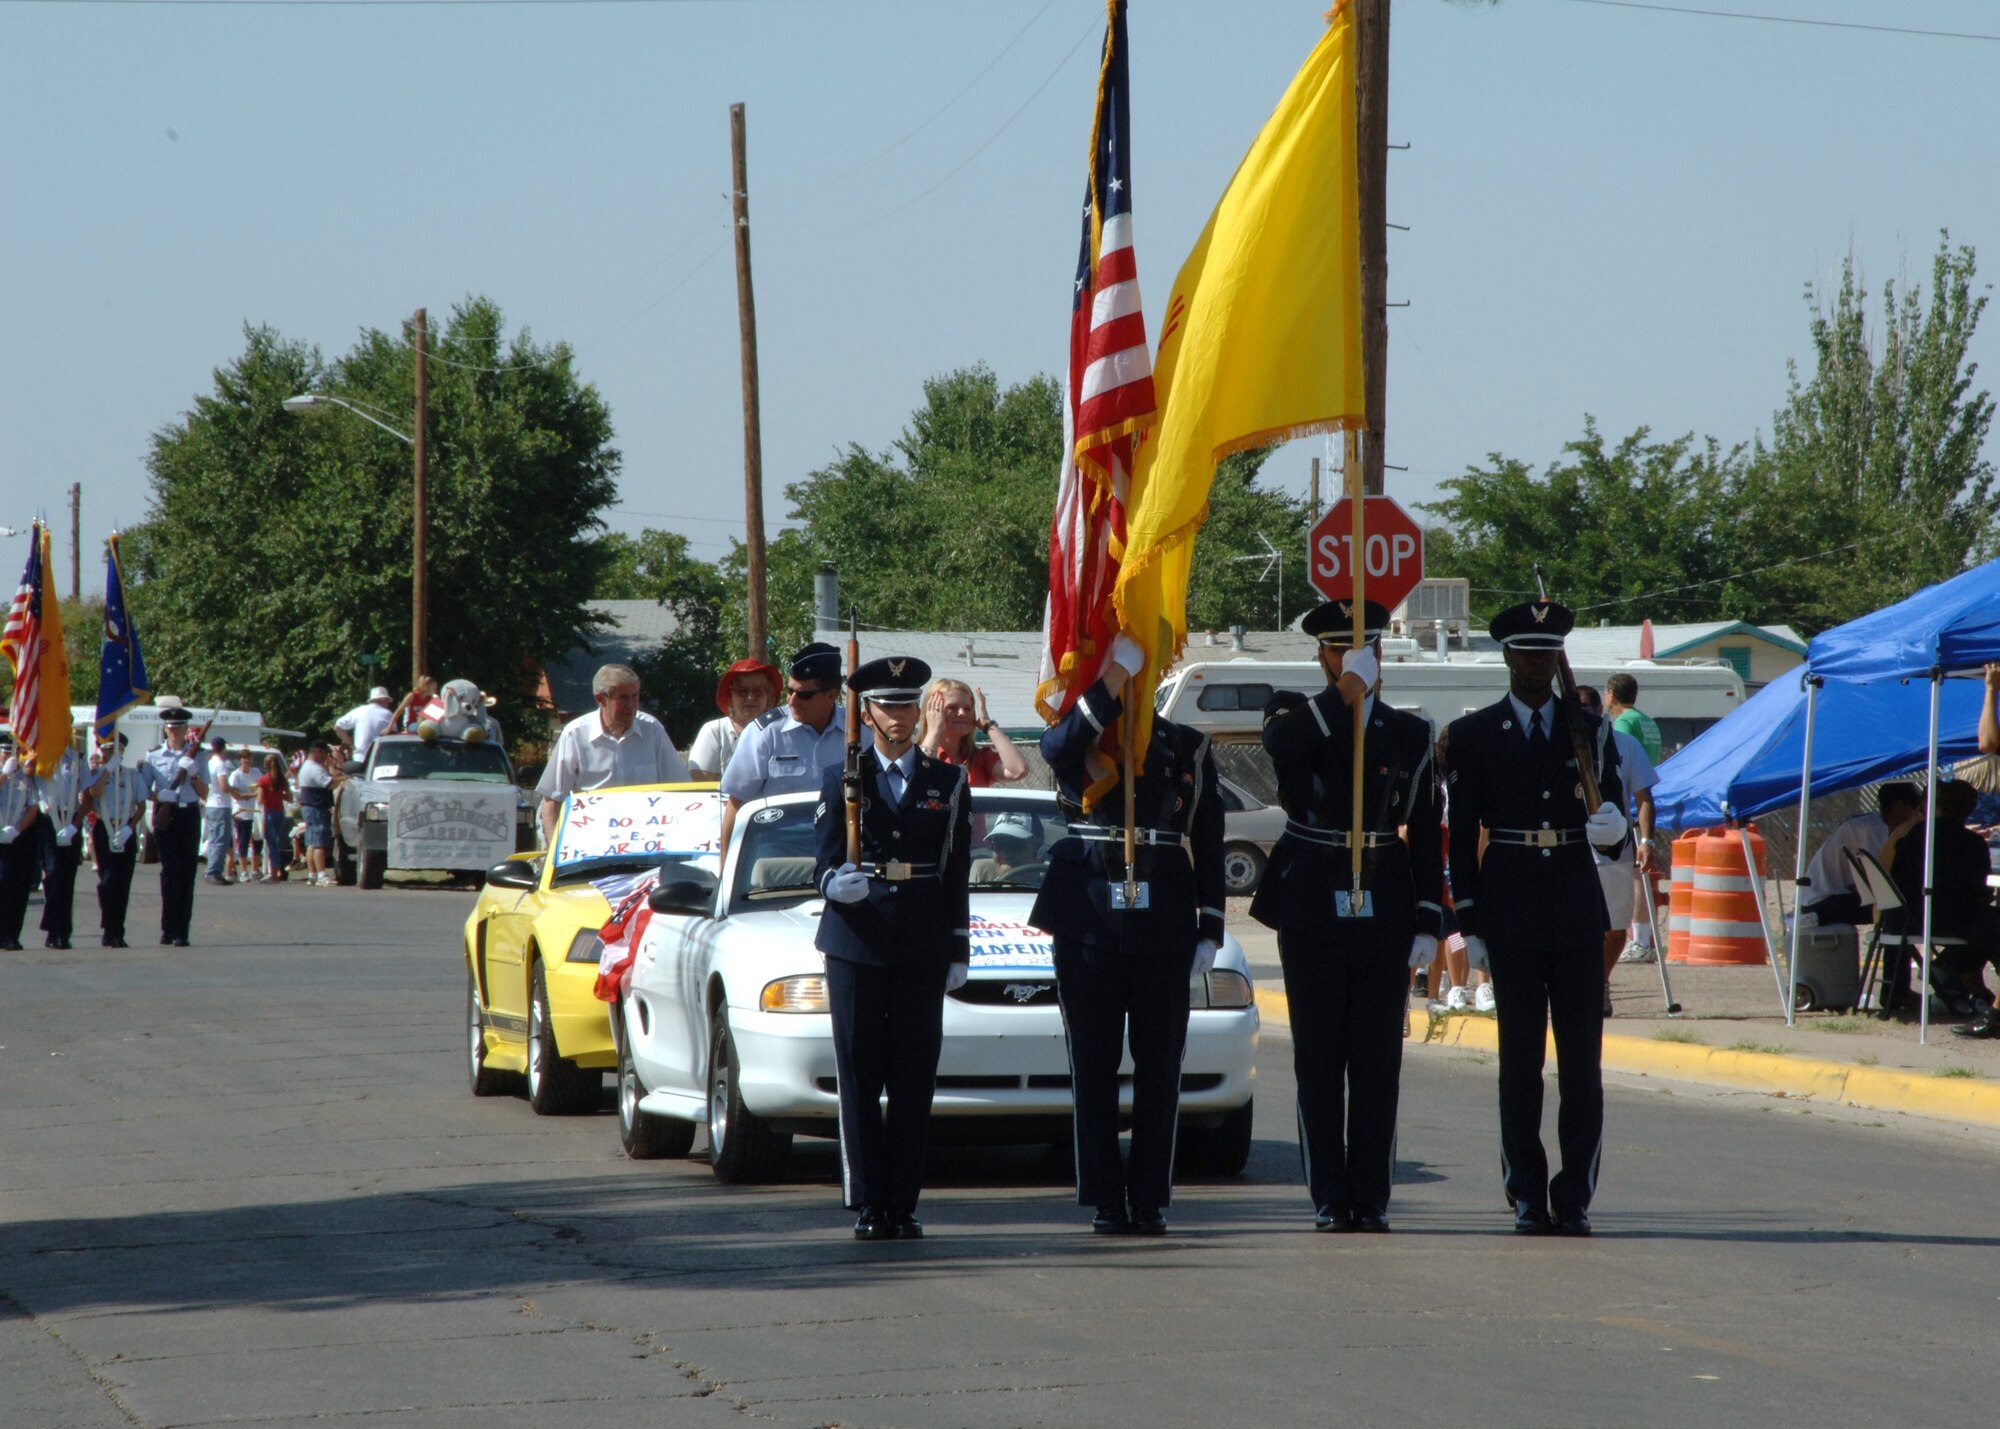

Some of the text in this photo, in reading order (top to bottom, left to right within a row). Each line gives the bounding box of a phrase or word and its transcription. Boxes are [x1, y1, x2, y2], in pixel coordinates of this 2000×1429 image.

[1317, 533, 1416, 578] STOP
[608, 814, 679, 828] DOAL
[427, 826, 478, 840] ARENA
[970, 922, 1028, 930] HALL
[970, 929, 1053, 938] EN DA
